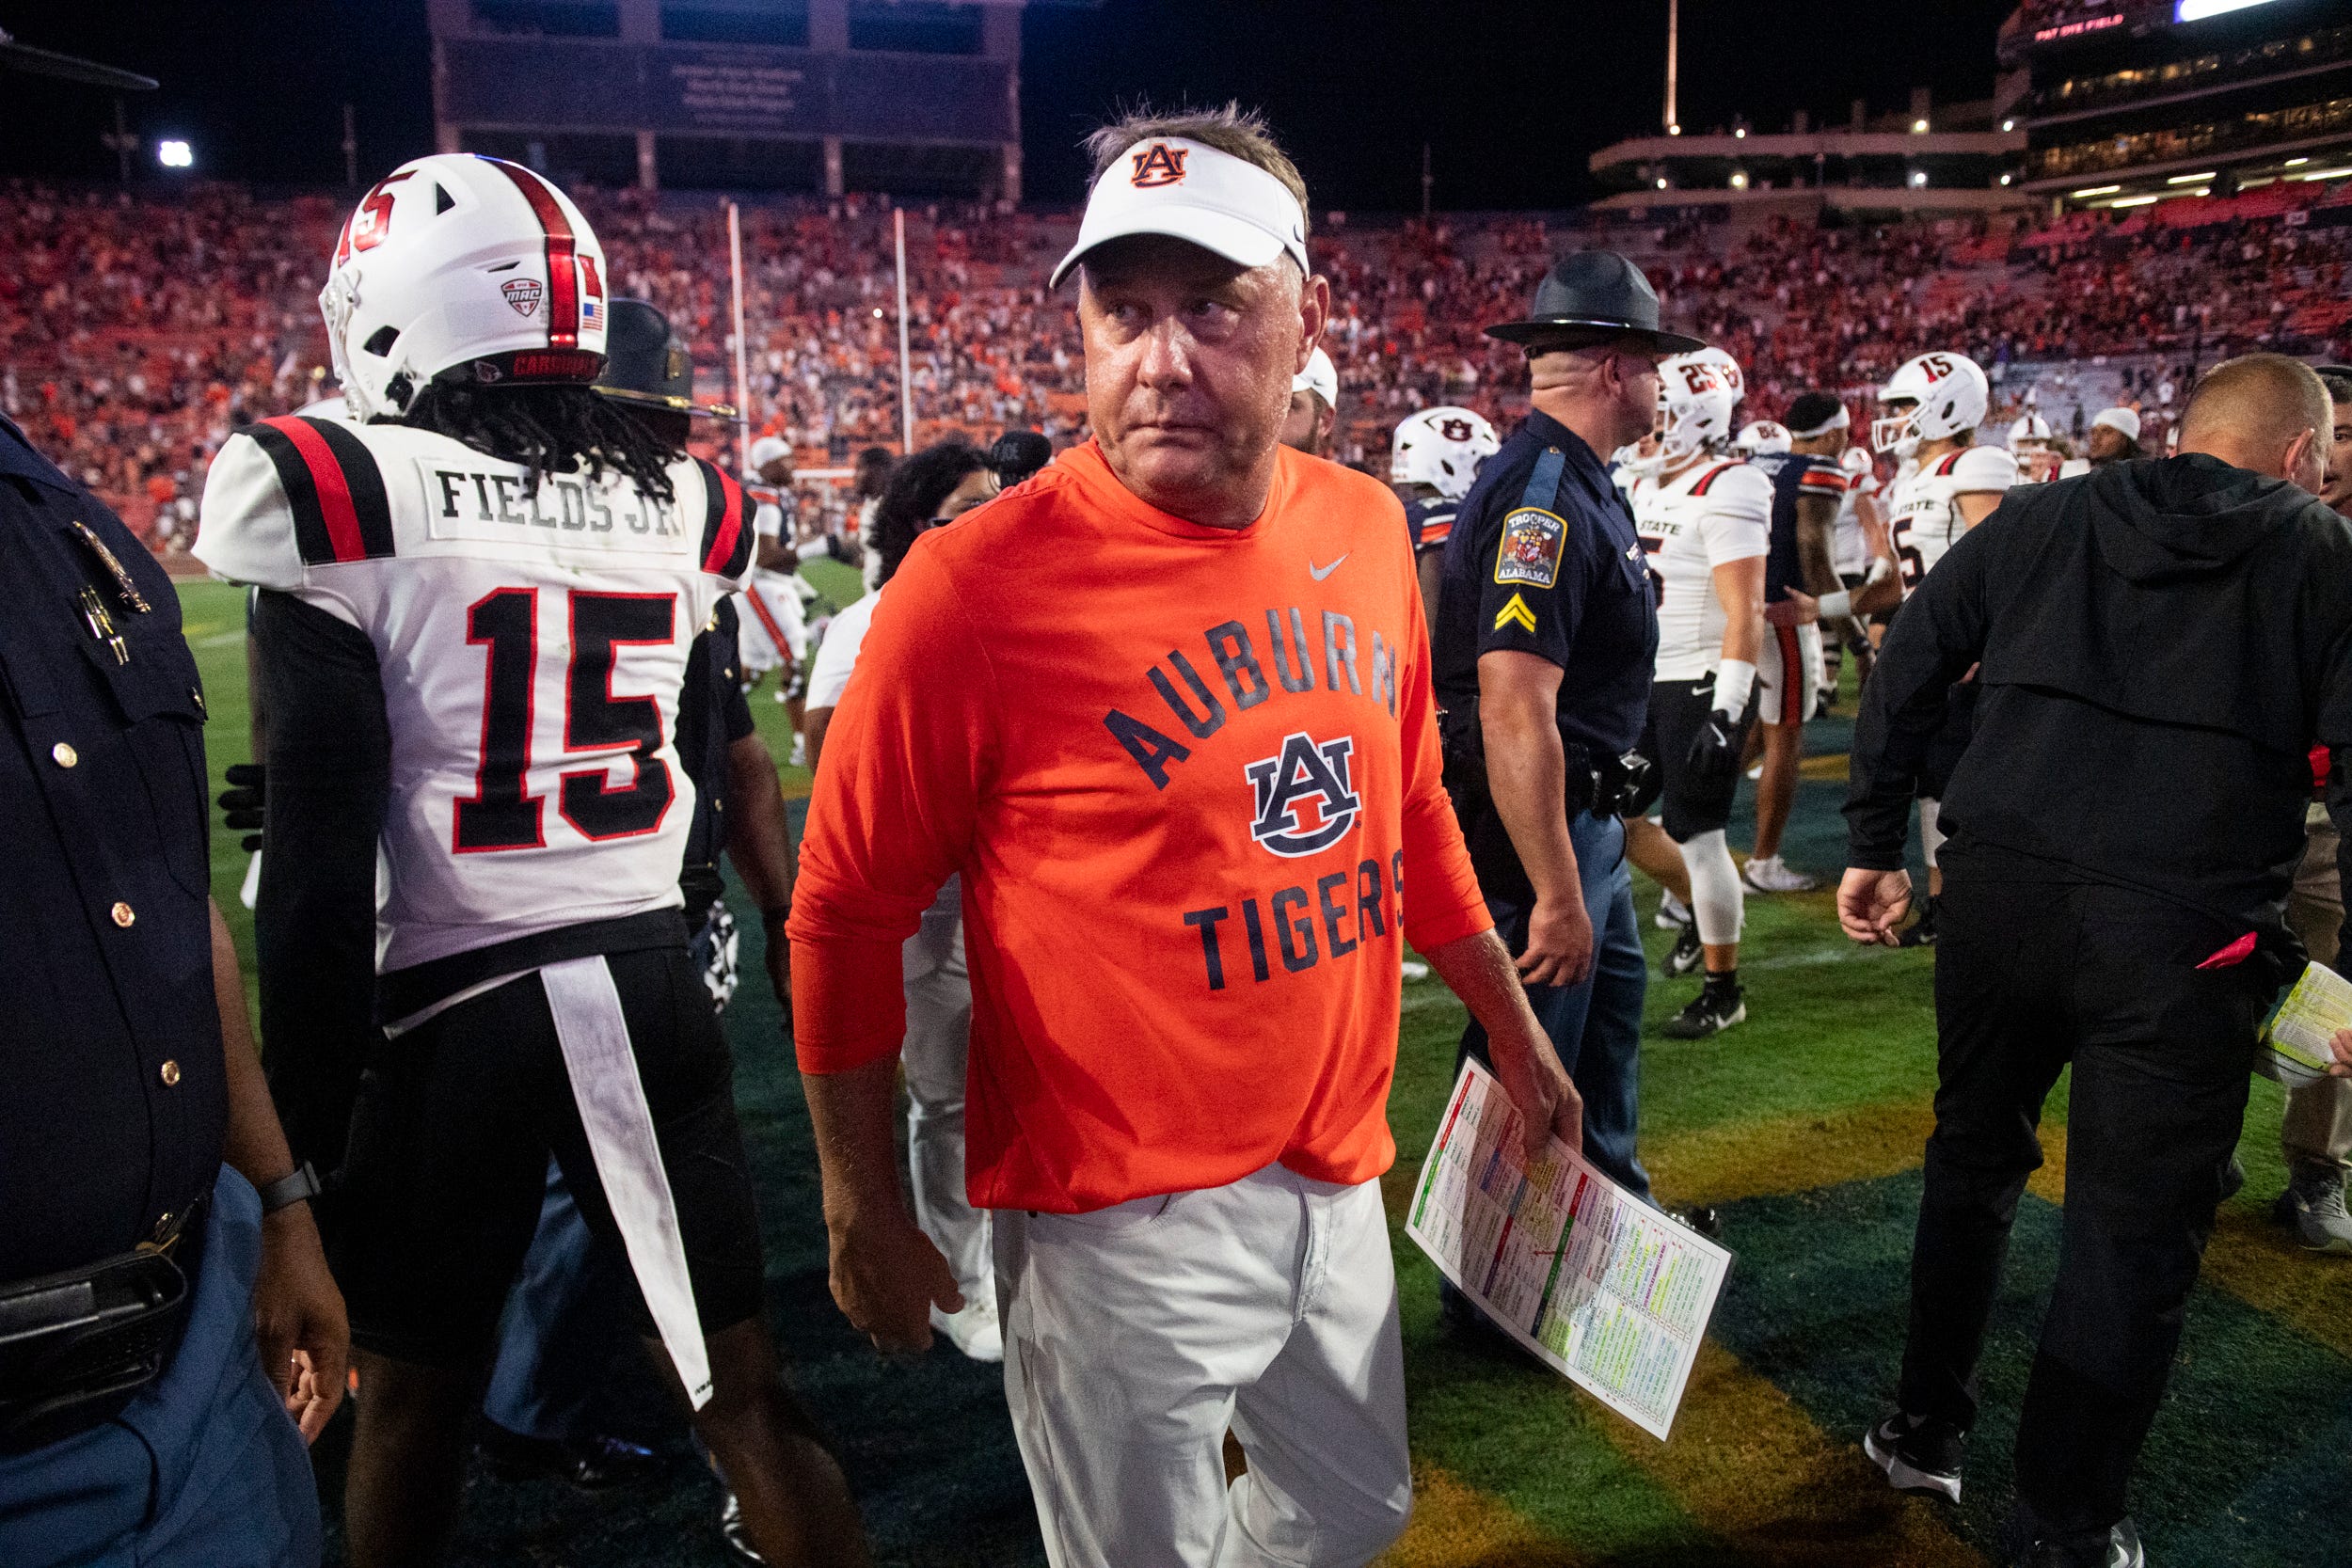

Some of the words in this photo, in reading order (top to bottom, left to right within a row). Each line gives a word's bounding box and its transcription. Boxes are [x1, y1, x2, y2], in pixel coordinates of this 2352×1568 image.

[2034, 27, 2059, 41] PAT
[2085, 13, 2124, 32] FIELD
[505, 289, 542, 303] MAC
[1677, 363, 1718, 395] 25
[1918, 355, 1954, 384] 15
[435, 469, 613, 533] FIELDS
[1899, 499, 1934, 515] STATE
[1508, 514, 1560, 531] TROOPER
[1640, 518, 1682, 536] STATE
[1499, 569, 1550, 584] ALABAMA
[1103, 607, 1398, 792] AUBURN
[452, 586, 678, 854] 15
